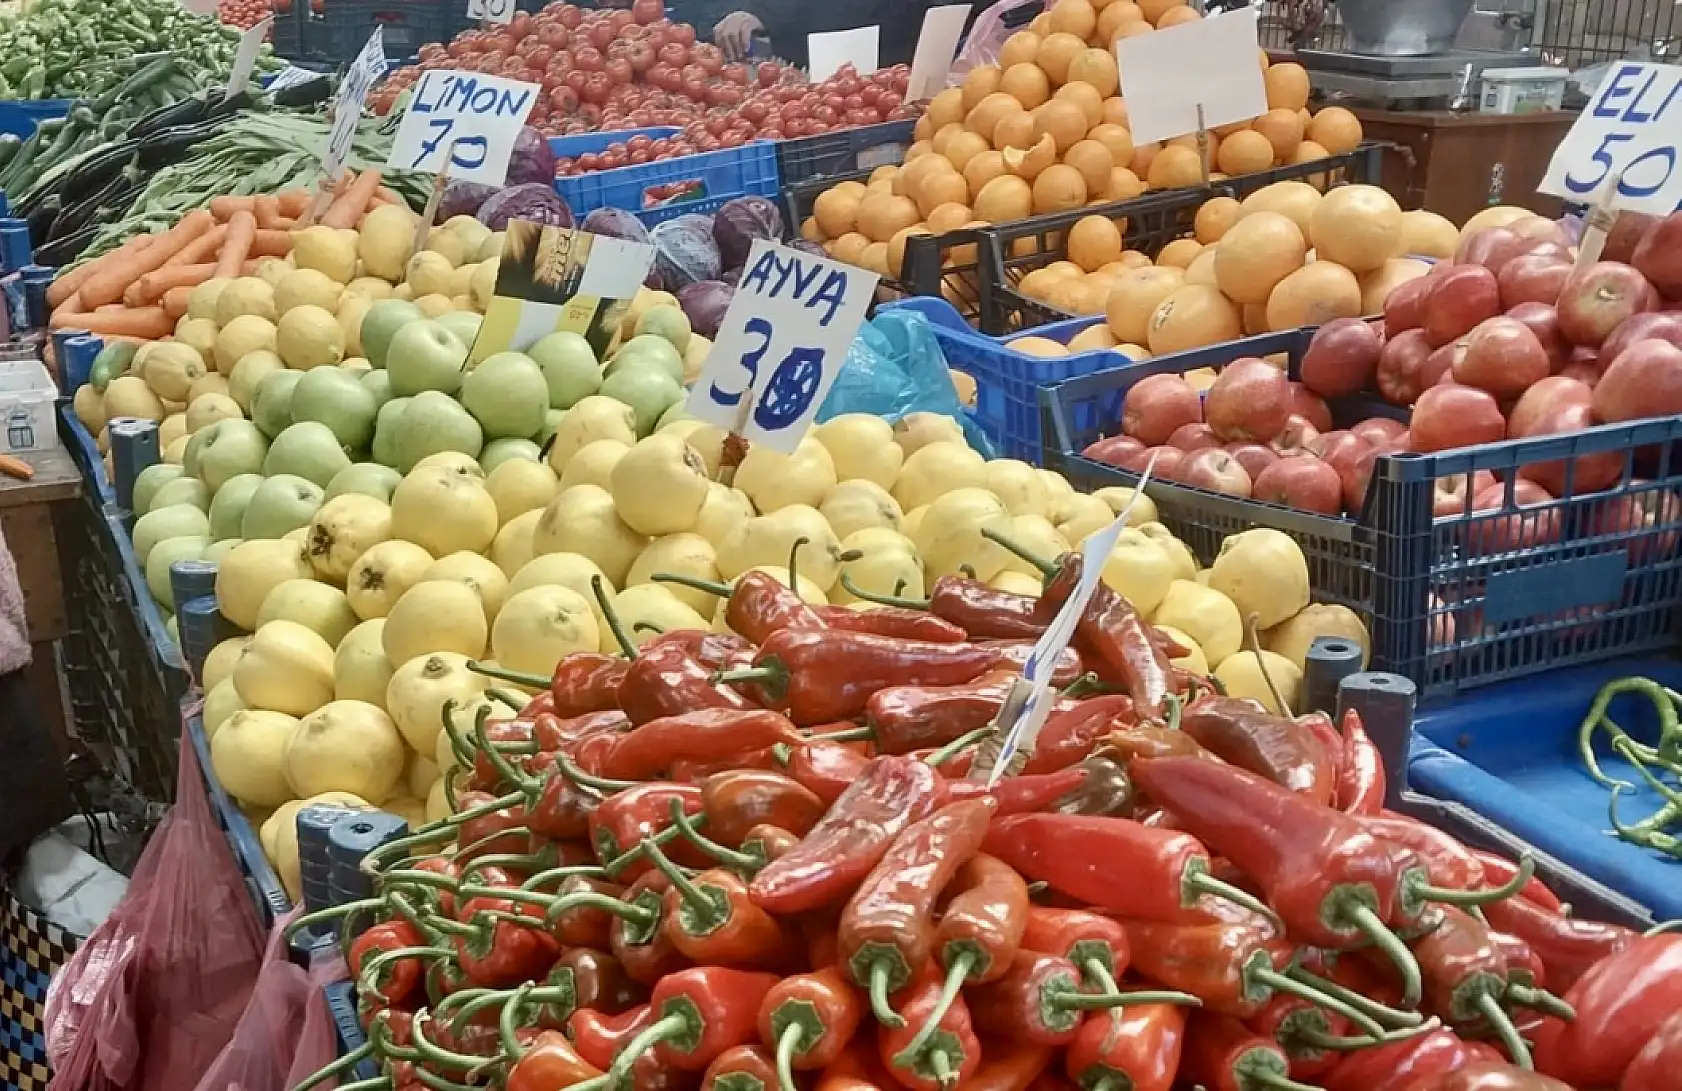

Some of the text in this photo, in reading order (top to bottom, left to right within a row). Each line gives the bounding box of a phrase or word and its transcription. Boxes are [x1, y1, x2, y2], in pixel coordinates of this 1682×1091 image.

[411, 118, 488, 169] 70
[1565, 132, 1677, 198] 50
[740, 249, 848, 327] AYVA
[709, 317, 826, 432] 30
